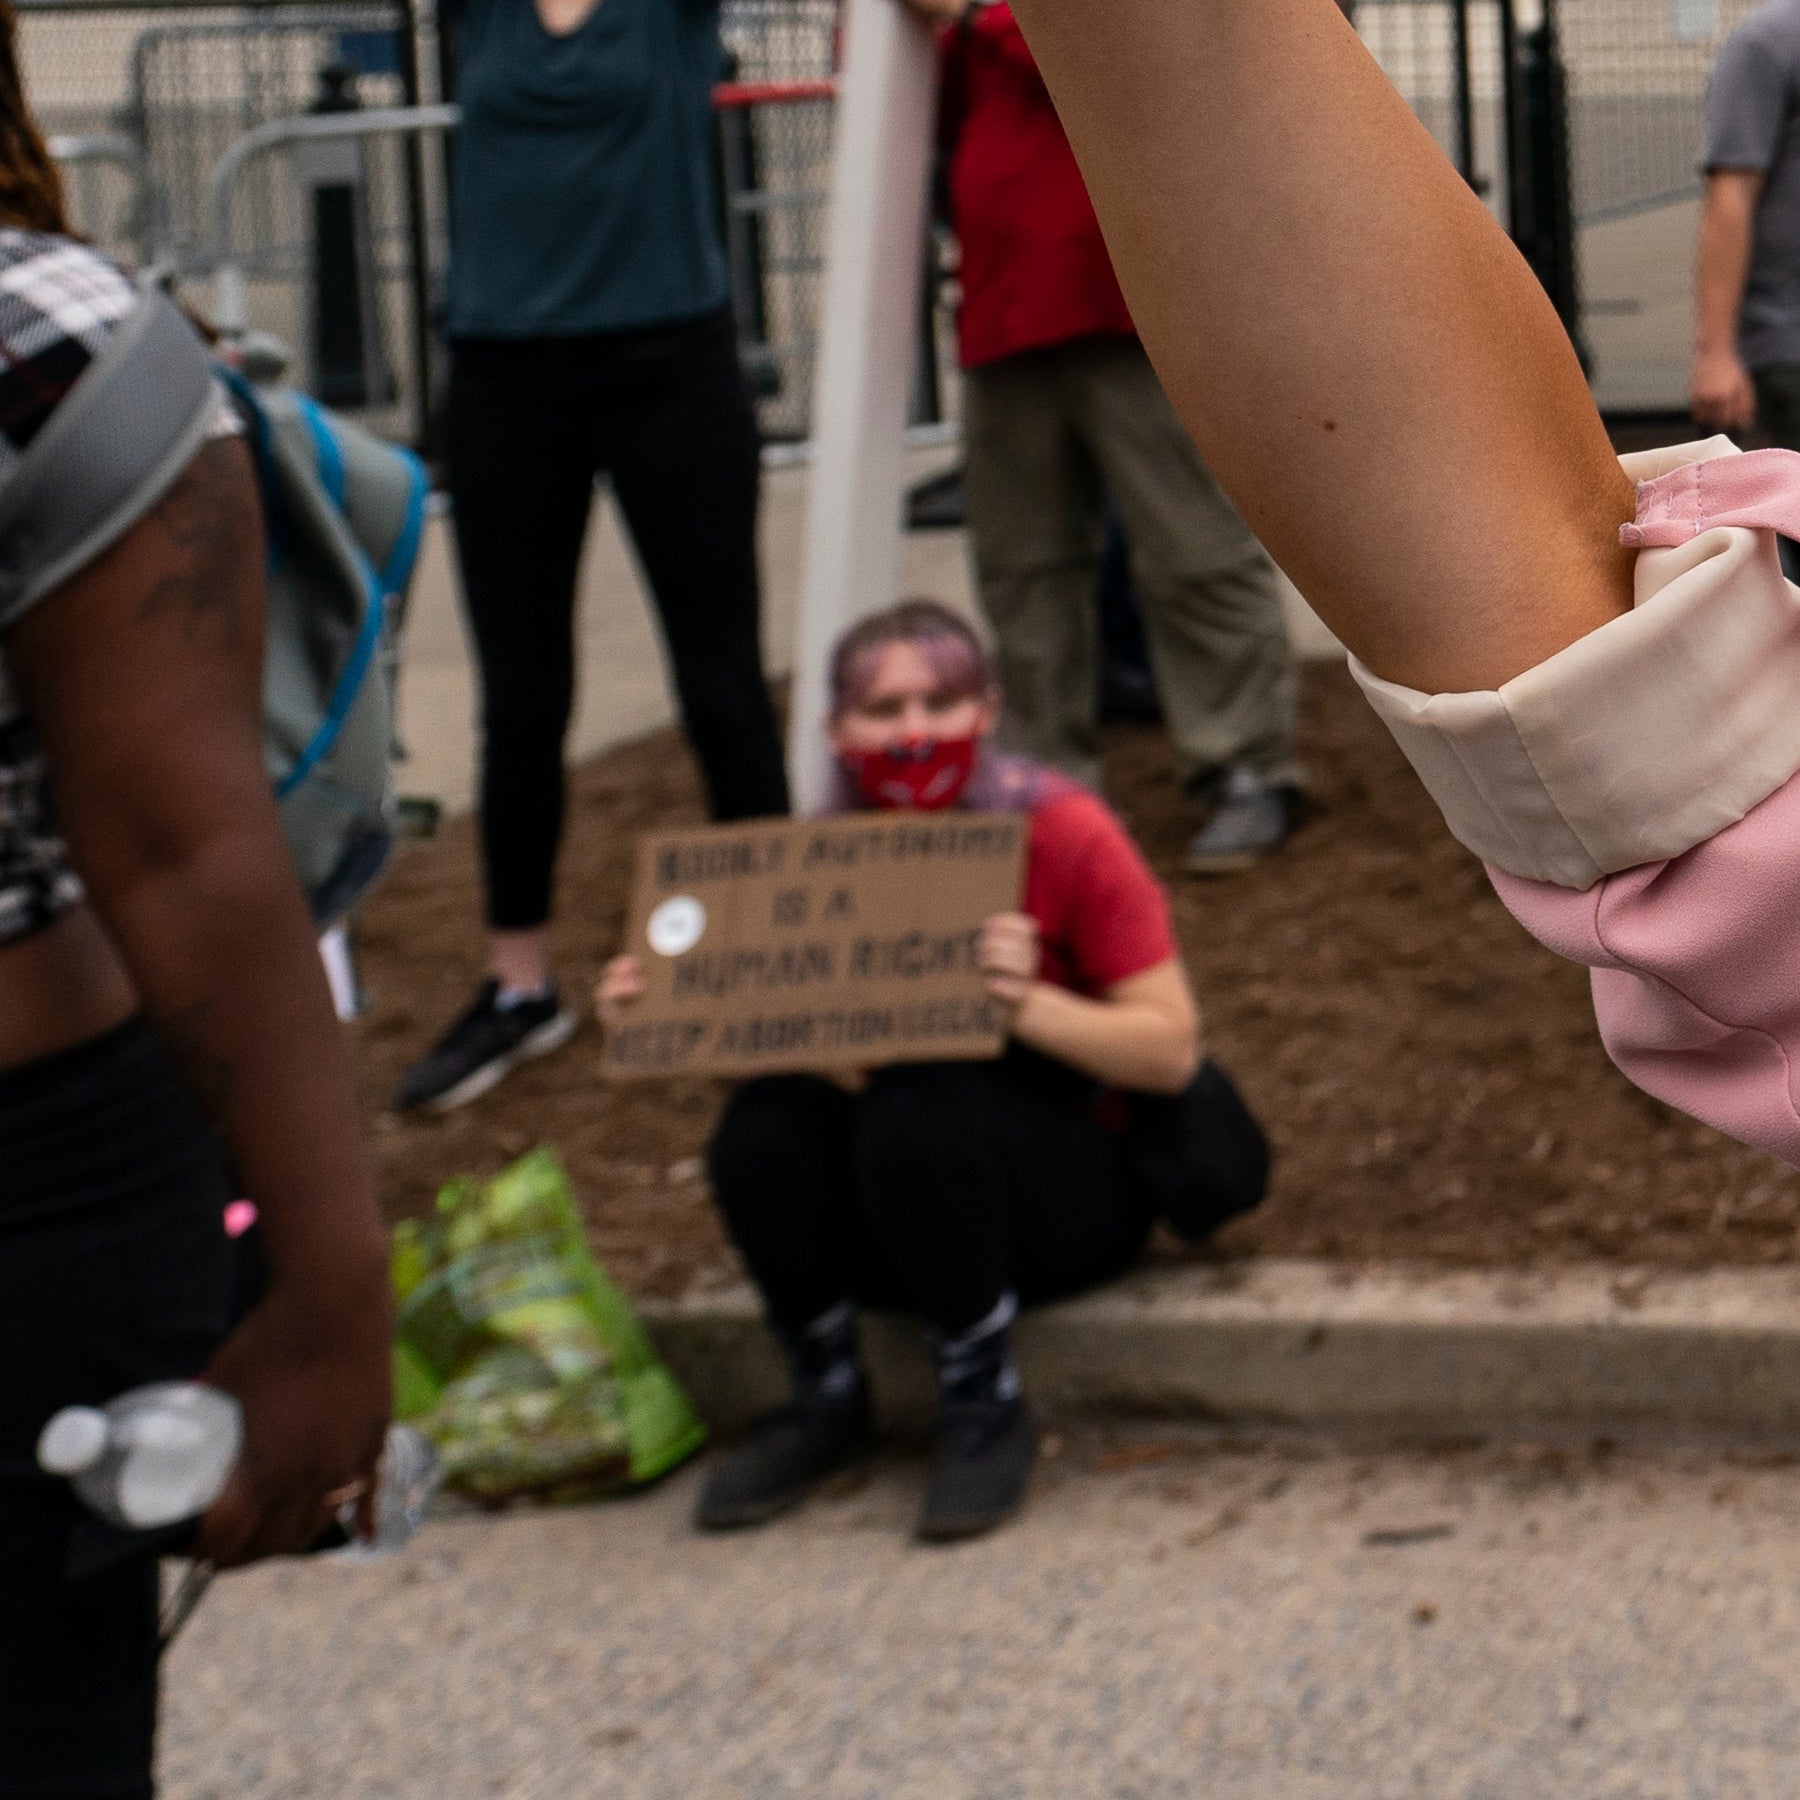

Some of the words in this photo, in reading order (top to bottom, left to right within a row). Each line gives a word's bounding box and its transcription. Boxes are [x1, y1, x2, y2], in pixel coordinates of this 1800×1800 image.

[653, 836, 786, 890] BODILY
[803, 822, 1017, 868] AUTONOMY
[772, 888, 808, 927] IS
[824, 884, 854, 920] A
[671, 940, 833, 1000] HUMAN
[716, 1003, 898, 1056] ABORTION
